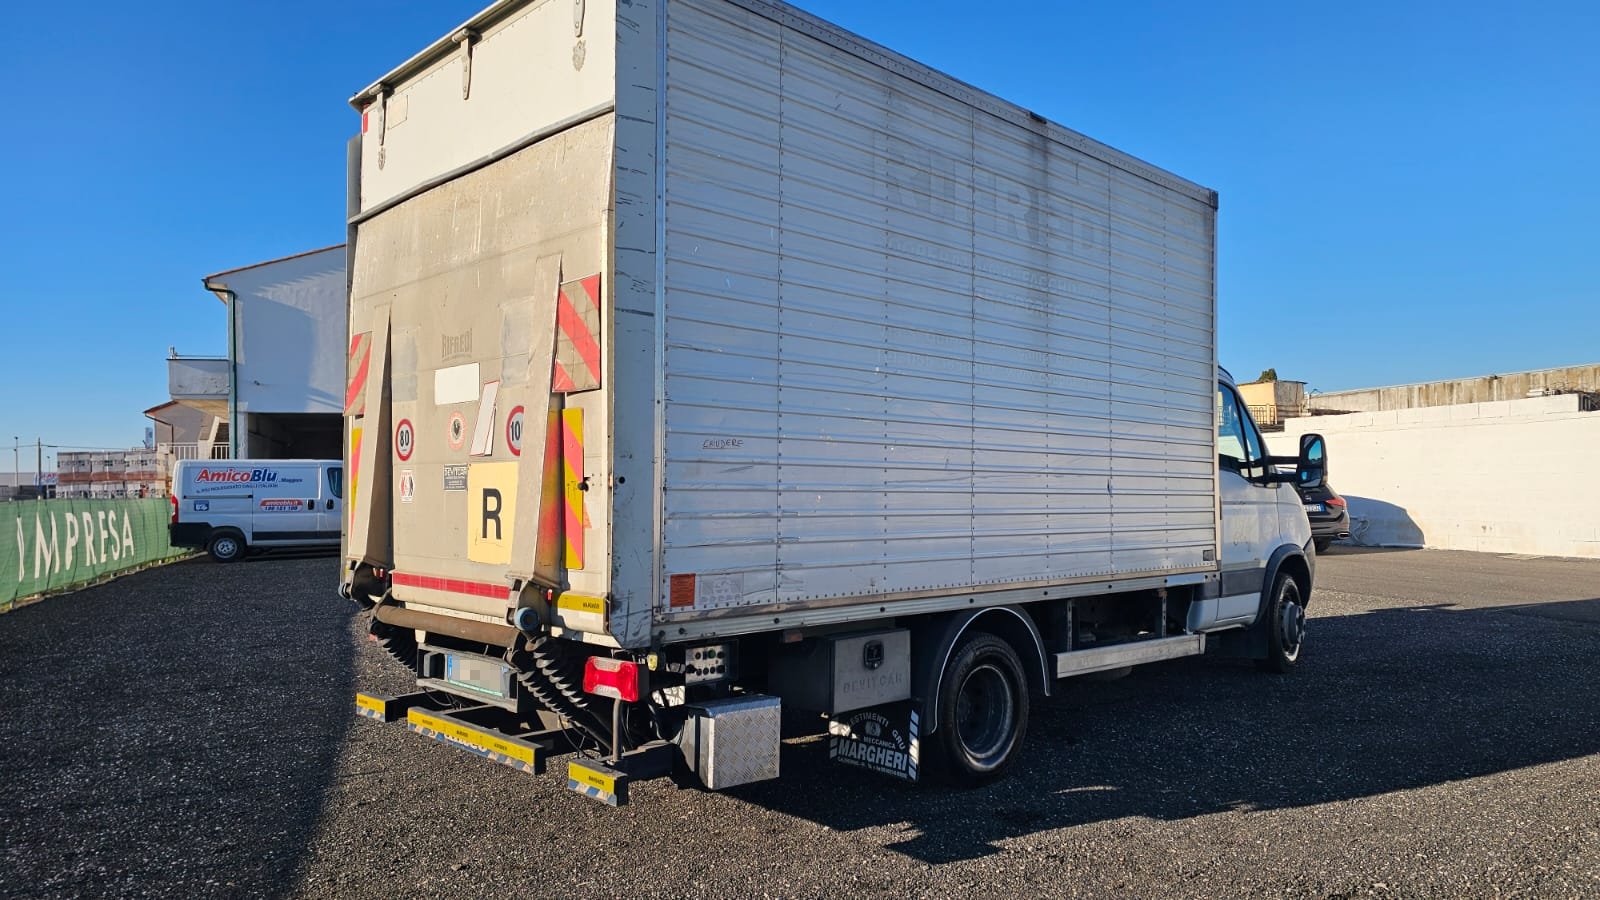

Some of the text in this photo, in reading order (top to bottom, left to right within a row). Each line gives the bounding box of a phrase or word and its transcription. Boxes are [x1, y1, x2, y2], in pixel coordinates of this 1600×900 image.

[400, 429, 410, 447] 80
[511, 420, 524, 441] 10
[195, 467, 279, 483] AmicoBlu
[482, 488, 502, 540] R
[17, 508, 135, 583] IMPRESA
[847, 711, 890, 728] ESTIMENTI
[863, 736, 897, 750] MECCANICA
[891, 729, 907, 751] GRU
[838, 738, 908, 772] MARGHERI
